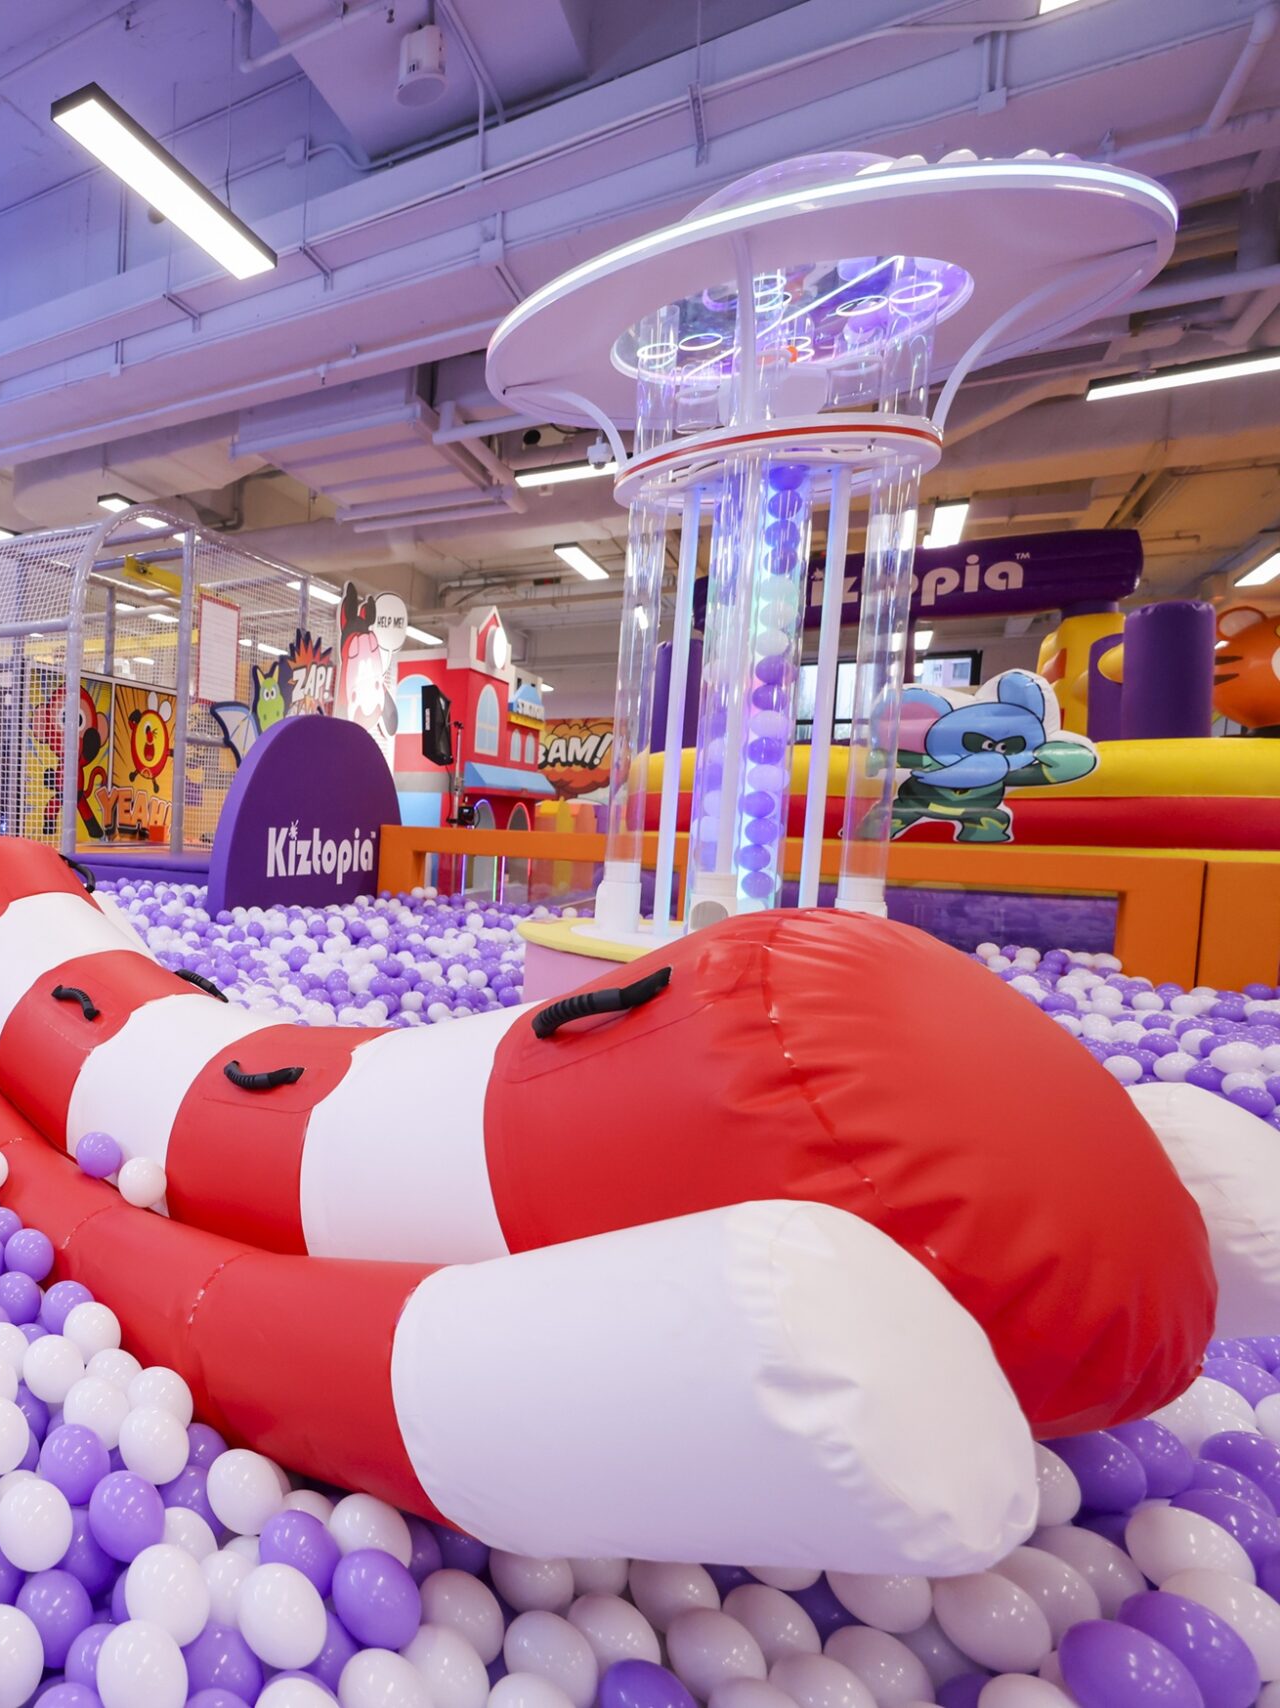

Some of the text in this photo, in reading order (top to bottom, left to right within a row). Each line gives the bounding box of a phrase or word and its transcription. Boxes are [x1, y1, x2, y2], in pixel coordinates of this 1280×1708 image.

[810, 553, 1024, 607] izpia
[377, 615, 405, 629] HELP ME!
[291, 662, 333, 703] ZAP!
[266, 820, 374, 885] Kiztopia
